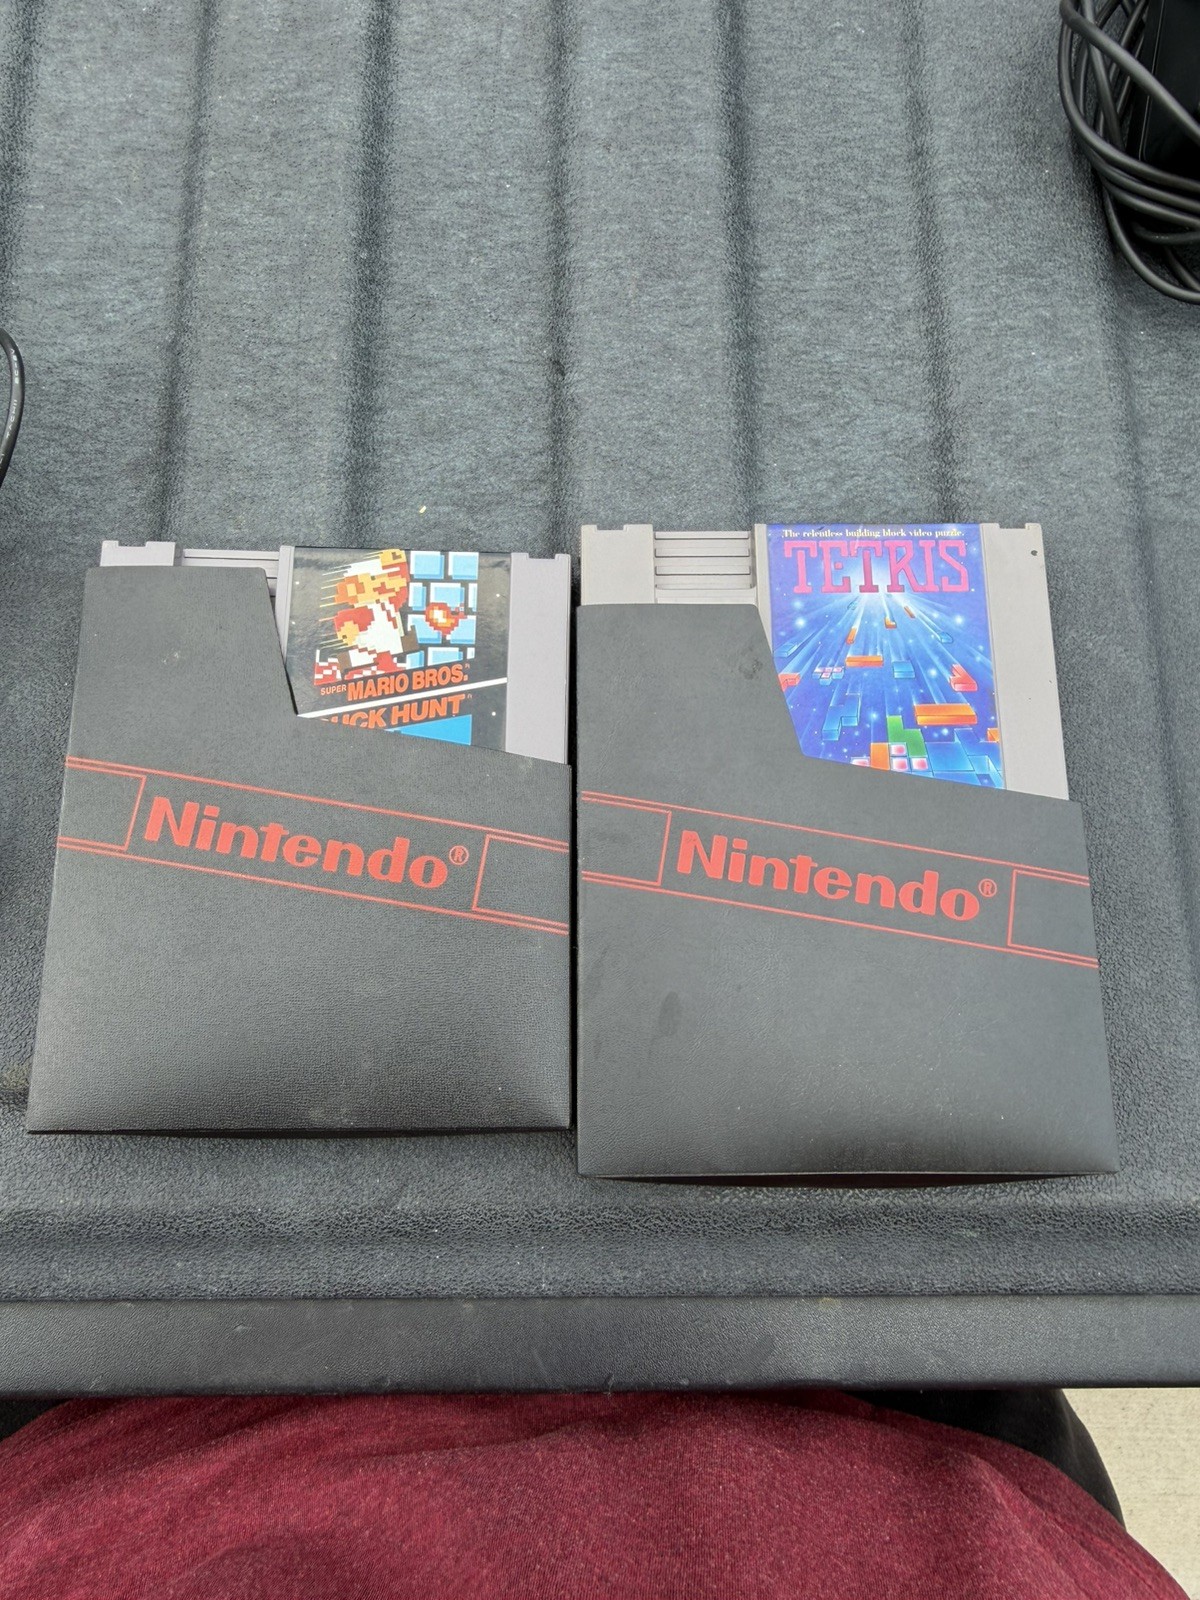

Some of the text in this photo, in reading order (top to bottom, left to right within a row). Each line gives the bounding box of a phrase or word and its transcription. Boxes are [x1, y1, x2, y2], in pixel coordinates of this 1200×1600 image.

[782, 528, 965, 539] The relentless building block video puzzle.
[783, 540, 970, 594] TETRIS
[320, 664, 468, 701] SUPER MARIO BROS.
[320, 693, 466, 729] CK HUNT
